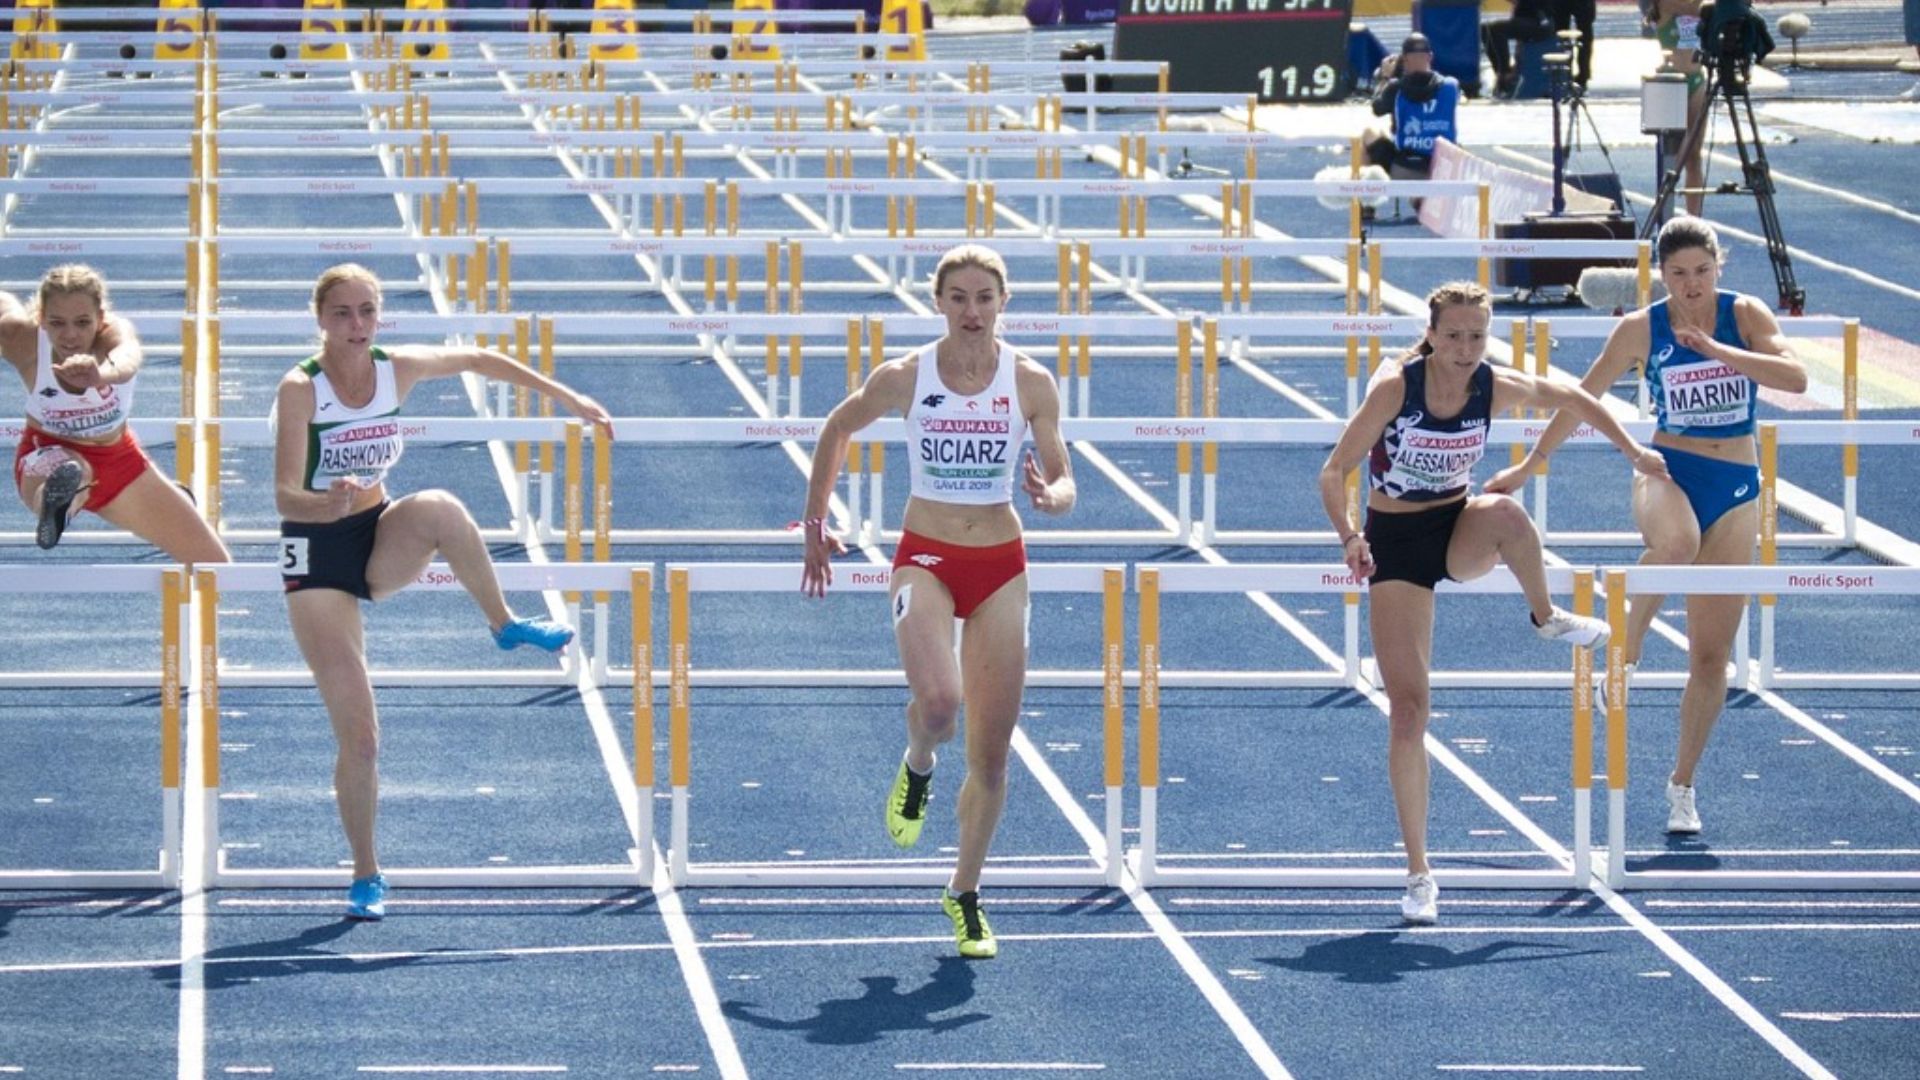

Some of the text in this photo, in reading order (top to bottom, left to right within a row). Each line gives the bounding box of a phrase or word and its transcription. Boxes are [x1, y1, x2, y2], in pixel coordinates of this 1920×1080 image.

[1257, 65, 1336, 97] 11.9
[1670, 379, 1746, 411] MARINI
[934, 419, 1008, 433] BAUHAUS
[920, 438, 1008, 464] SICIARZ
[284, 543, 296, 569] 5
[1836, 575, 1874, 590] Sport
